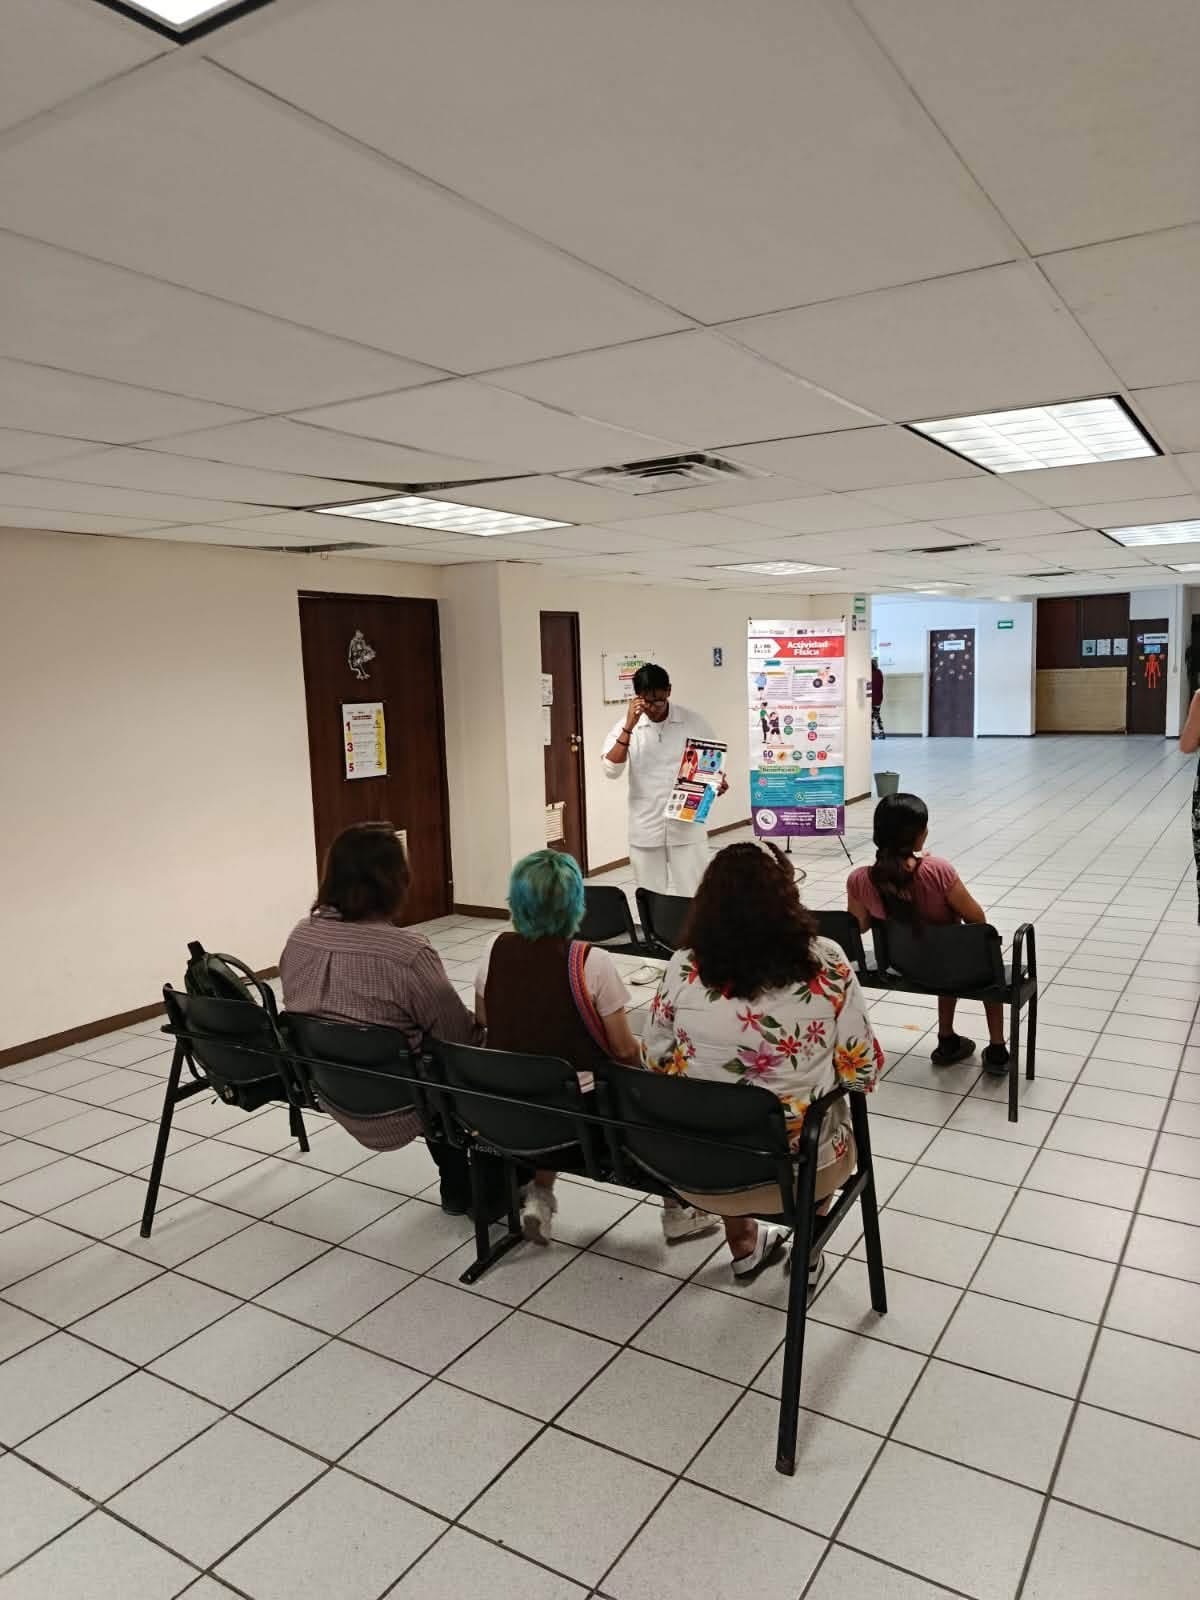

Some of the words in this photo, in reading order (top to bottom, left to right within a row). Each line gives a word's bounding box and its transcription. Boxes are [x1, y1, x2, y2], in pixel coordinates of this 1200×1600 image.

[787, 640, 829, 649] Actividad
[345, 721, 351, 731] 1
[347, 742, 354, 752] 3
[348, 762, 354, 772] 5
